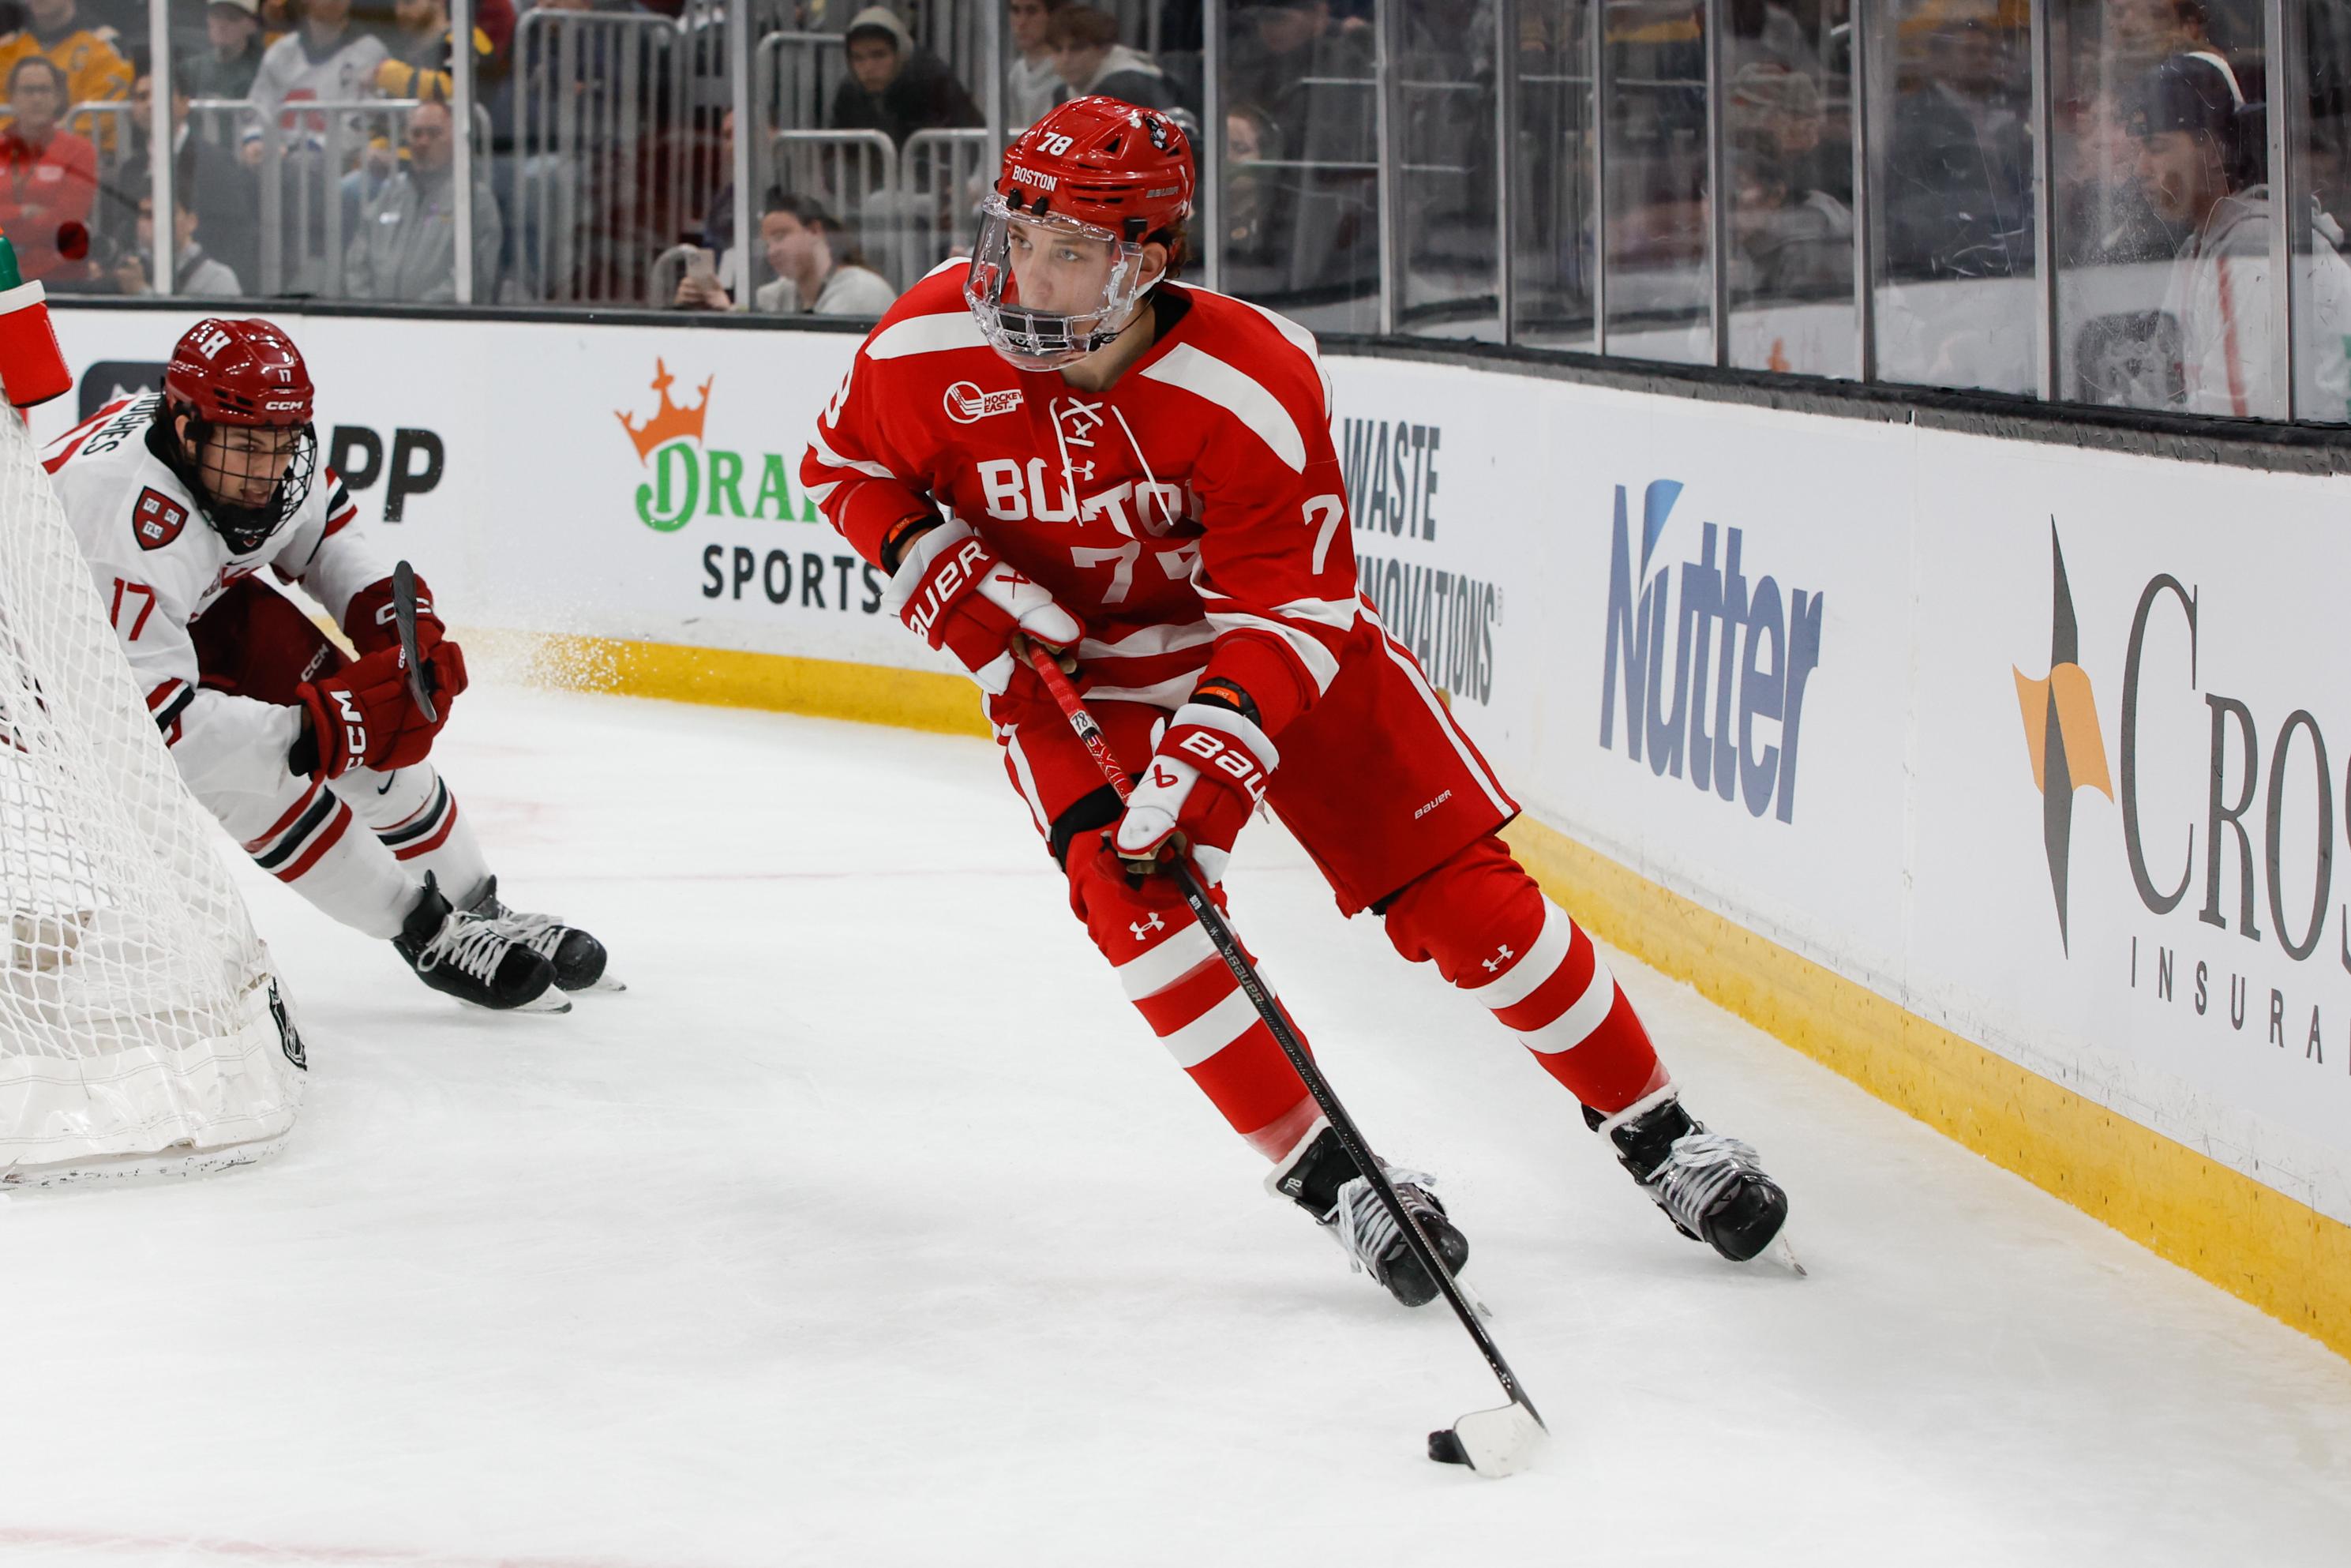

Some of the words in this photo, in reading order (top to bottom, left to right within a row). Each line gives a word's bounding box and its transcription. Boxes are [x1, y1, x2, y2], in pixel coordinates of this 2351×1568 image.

[1037, 132, 1074, 156] 78
[1012, 165, 1058, 193] BOSTON
[199, 329, 231, 361] H
[279, 369, 292, 383] 17
[264, 400, 304, 411] CCM
[984, 392, 1022, 405] HOCKEY
[984, 403, 1010, 414] EAST
[1344, 418, 1441, 542] WASTE
[702, 543, 883, 614] SPORTS
[110, 576, 156, 642] 17
[301, 643, 330, 682] CCM
[1599, 478, 1824, 826] Nutter
[1071, 711, 1089, 731] 78
[2120, 572, 2351, 976] CRO
[2132, 936, 2351, 1076] INSURA
[1284, 1177, 1303, 1193] 78
